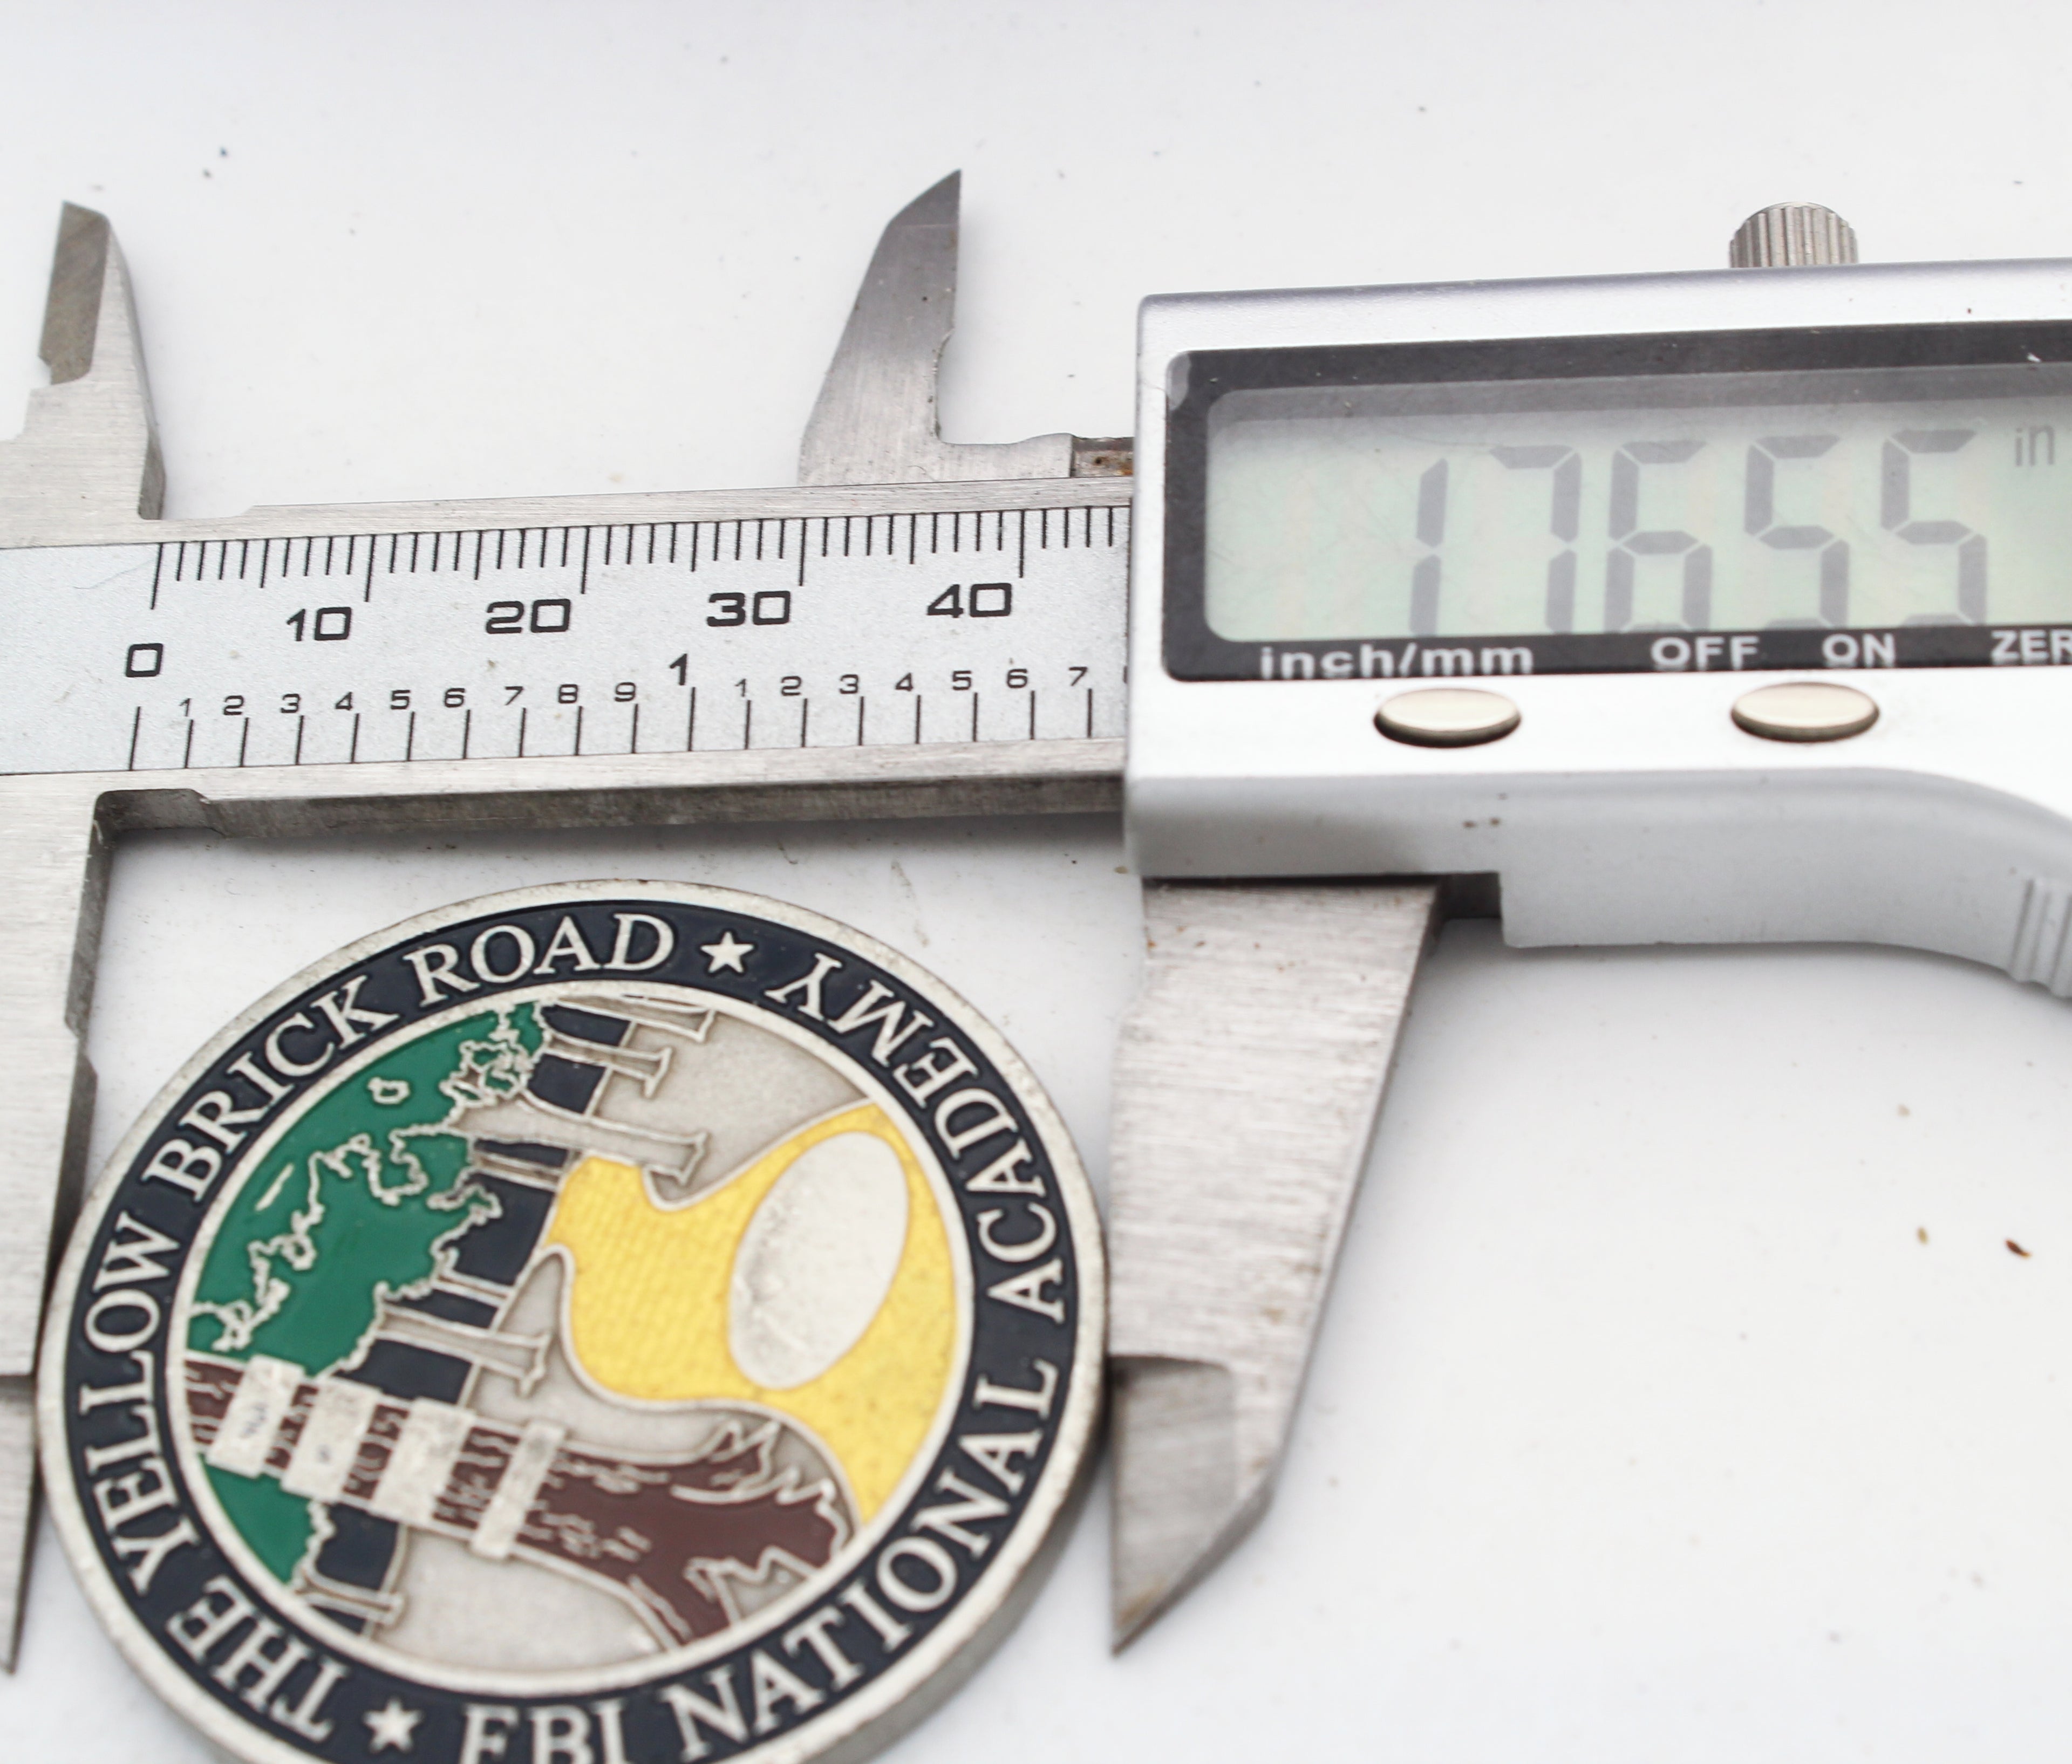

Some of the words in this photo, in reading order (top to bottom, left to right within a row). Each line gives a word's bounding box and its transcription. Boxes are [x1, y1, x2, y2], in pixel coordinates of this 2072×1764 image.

[2015, 424, 2055, 467] in
[287, 606, 352, 641] 10
[485, 598, 572, 634] 20
[706, 590, 791, 627] 30
[926, 583, 1013, 618] 40
[125, 642, 163, 678] 0
[669, 653, 687, 686] 1
[1260, 643, 1533, 680] inch/mm
[1651, 636, 1760, 672] OFF
[1822, 633, 1897, 667] ON
[179, 698, 190, 716] 1
[223, 695, 244, 716] 2
[280, 693, 301, 714] 3
[335, 692, 353, 711] 4
[390, 689, 411, 710] 5
[444, 688, 465, 708] 6
[504, 686, 523, 706] 7
[557, 684, 578, 704] 8
[614, 682, 636, 702] 9
[735, 679, 747, 697] 1
[780, 676, 802, 696] 2
[839, 674, 859, 694] 3
[895, 673, 914, 692] 4
[952, 670, 972, 690] 5
[1006, 668, 1028, 689] 6
[1068, 666, 1088, 687] 7
[403, 914, 676, 1008] ROAD
[140, 975, 400, 1202] BRICK
[765, 952, 1066, 1324] ACADEMY
[79, 1213, 199, 1595] YELLOW
[660, 1359, 1059, 1761] NATIONAL
[166, 1575, 347, 1742] THE
[460, 1699, 628, 1764] FBI
